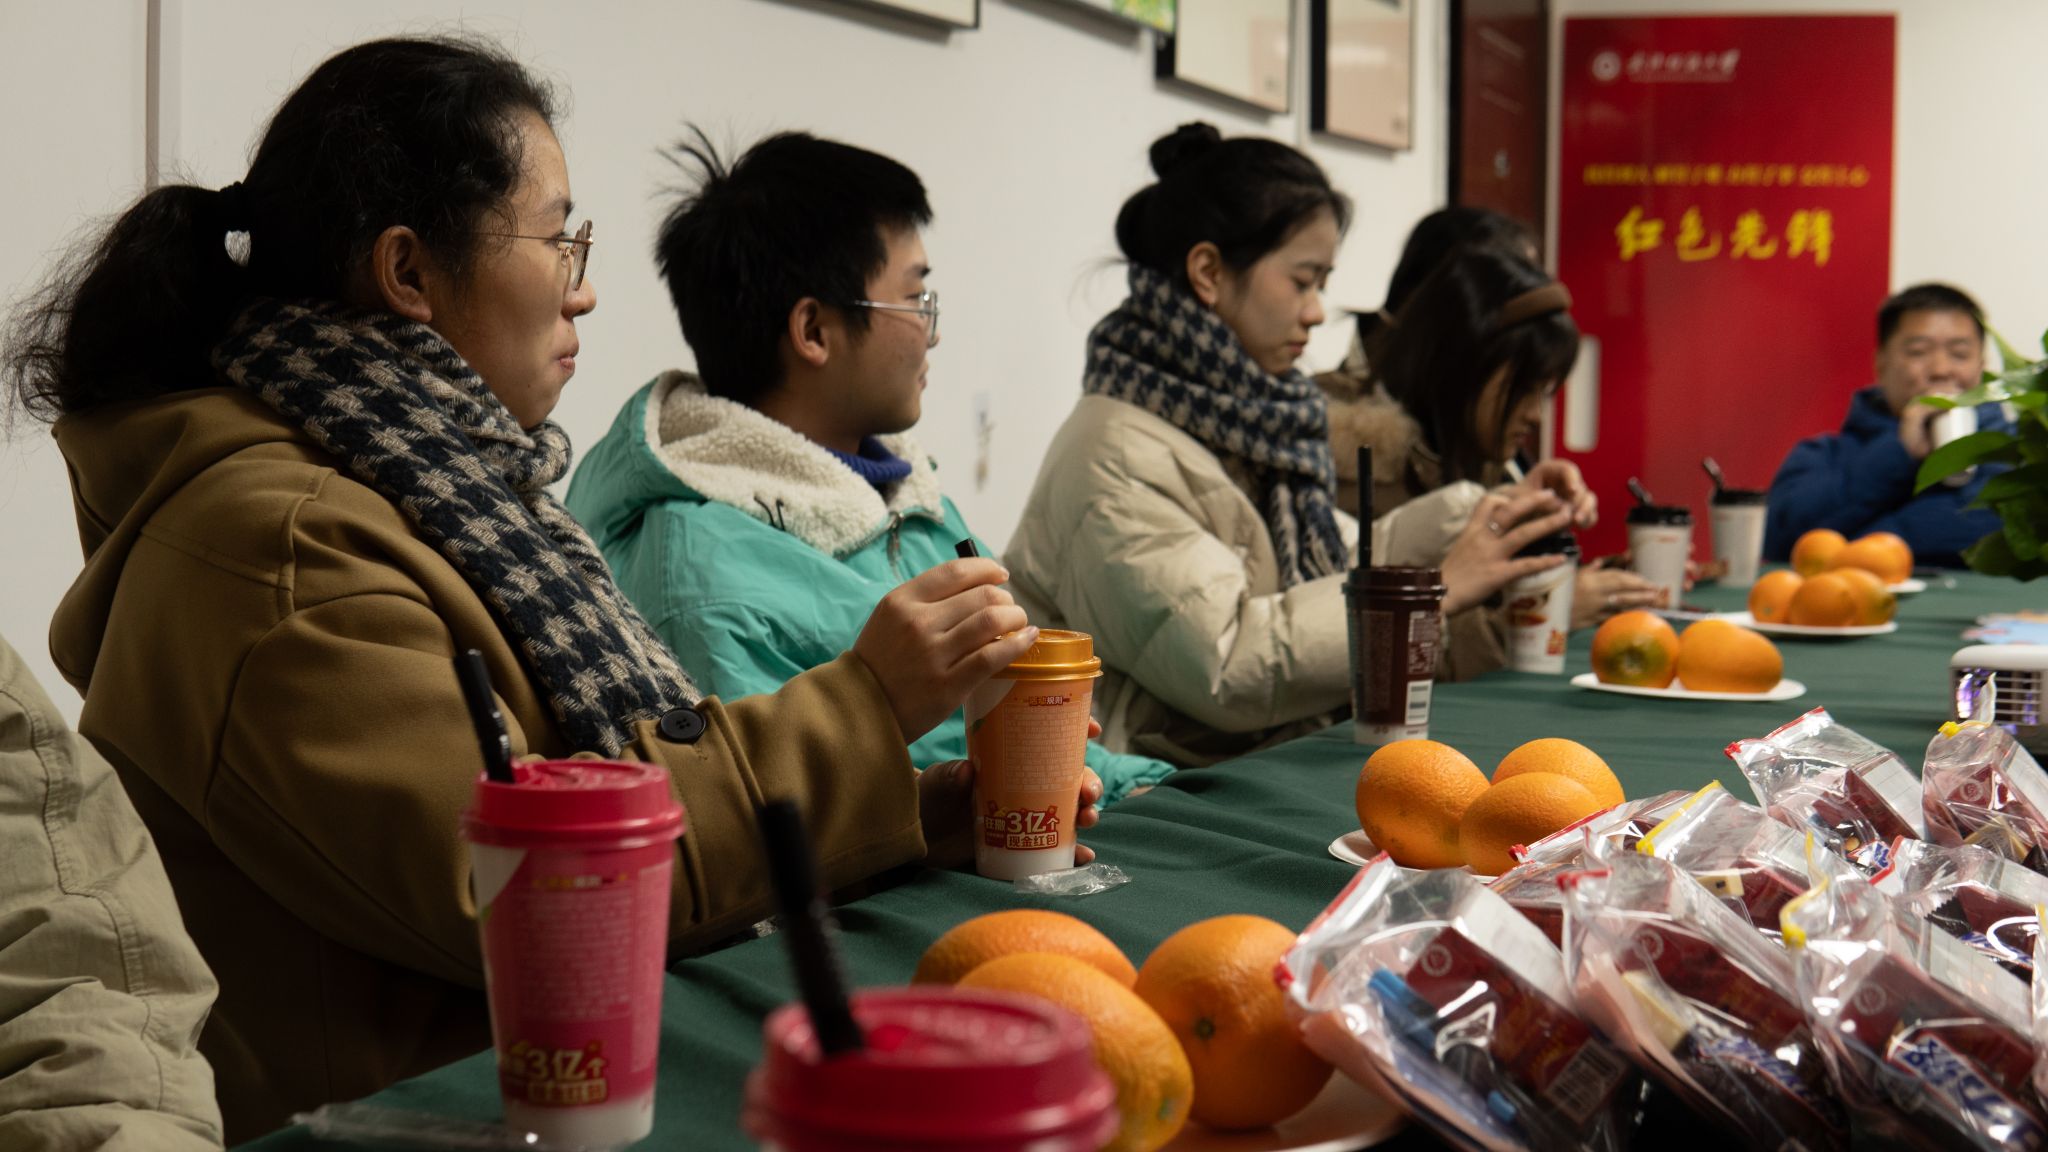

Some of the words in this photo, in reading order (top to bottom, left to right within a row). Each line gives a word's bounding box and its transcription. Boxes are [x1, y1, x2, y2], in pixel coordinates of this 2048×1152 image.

[1615, 205, 1834, 268] 红色先锋
[1009, 834, 1056, 848] 现金红包
